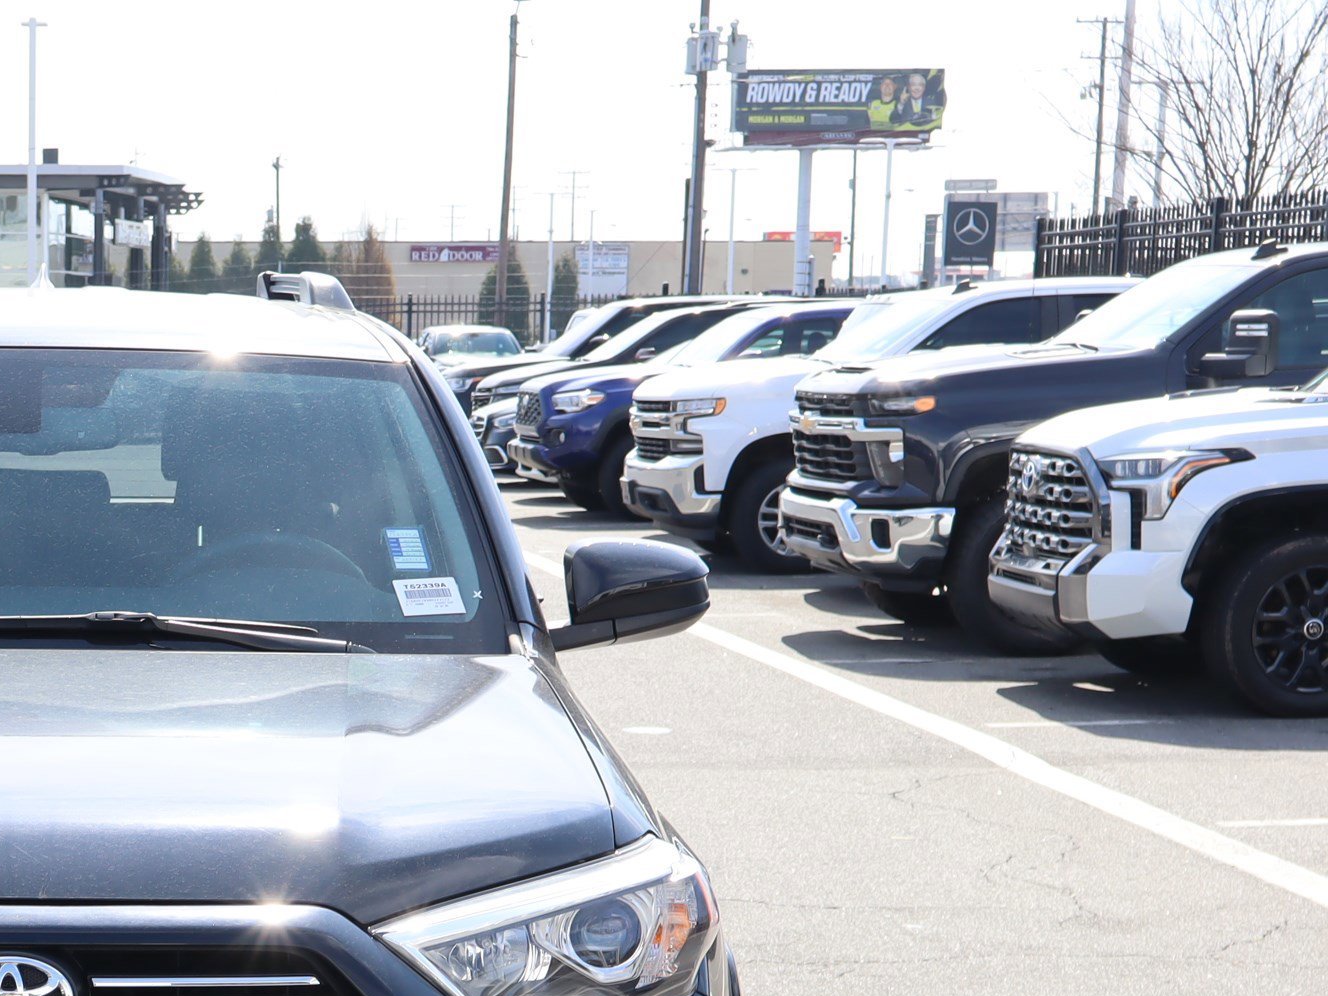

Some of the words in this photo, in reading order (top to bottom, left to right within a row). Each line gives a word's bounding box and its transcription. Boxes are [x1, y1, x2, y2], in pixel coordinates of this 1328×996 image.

[746, 83, 804, 103] ROWDY
[805, 83, 817, 102] &
[819, 82, 872, 102] READY
[412, 251, 438, 261] RED
[449, 251, 483, 261] DOOR
